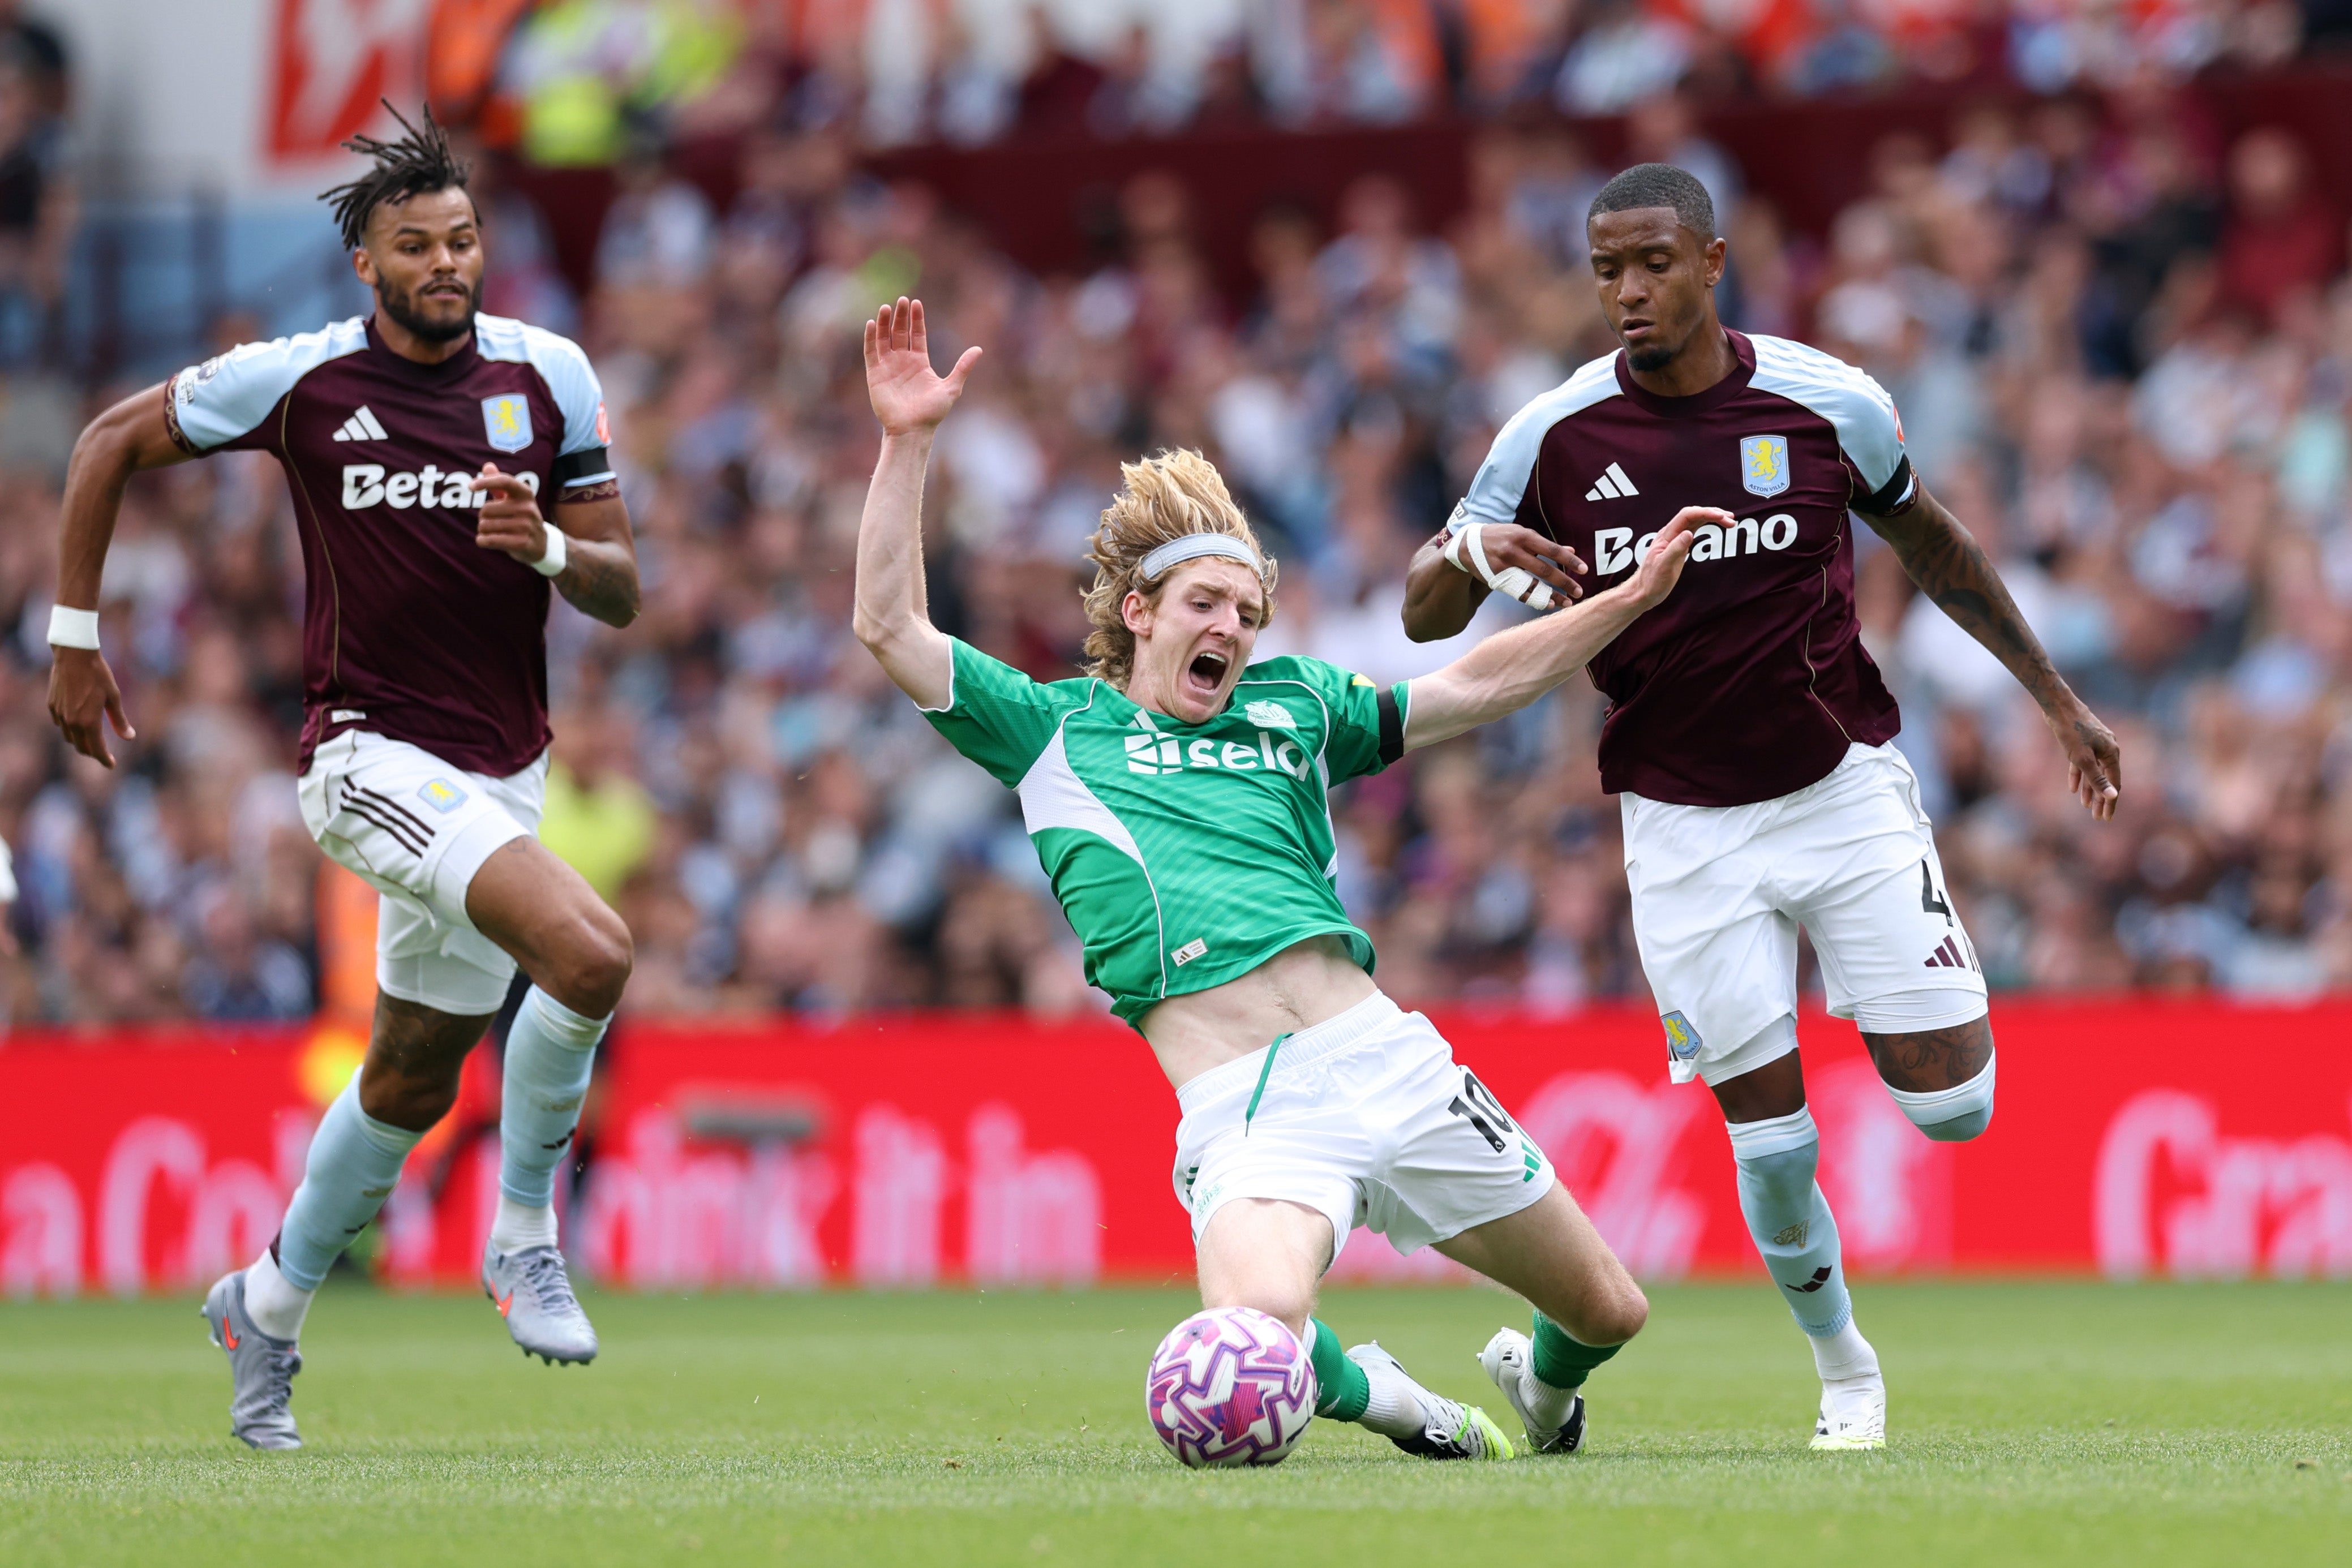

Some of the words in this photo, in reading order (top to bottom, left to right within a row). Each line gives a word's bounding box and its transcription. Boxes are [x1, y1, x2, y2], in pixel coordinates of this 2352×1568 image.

[1770, 482, 1785, 491] VILLA
[1595, 514, 1797, 576] Beano
[1188, 732, 1310, 781] sela
[1448, 1072, 1513, 1154] 10
[2094, 1085, 2352, 1280] Gra
